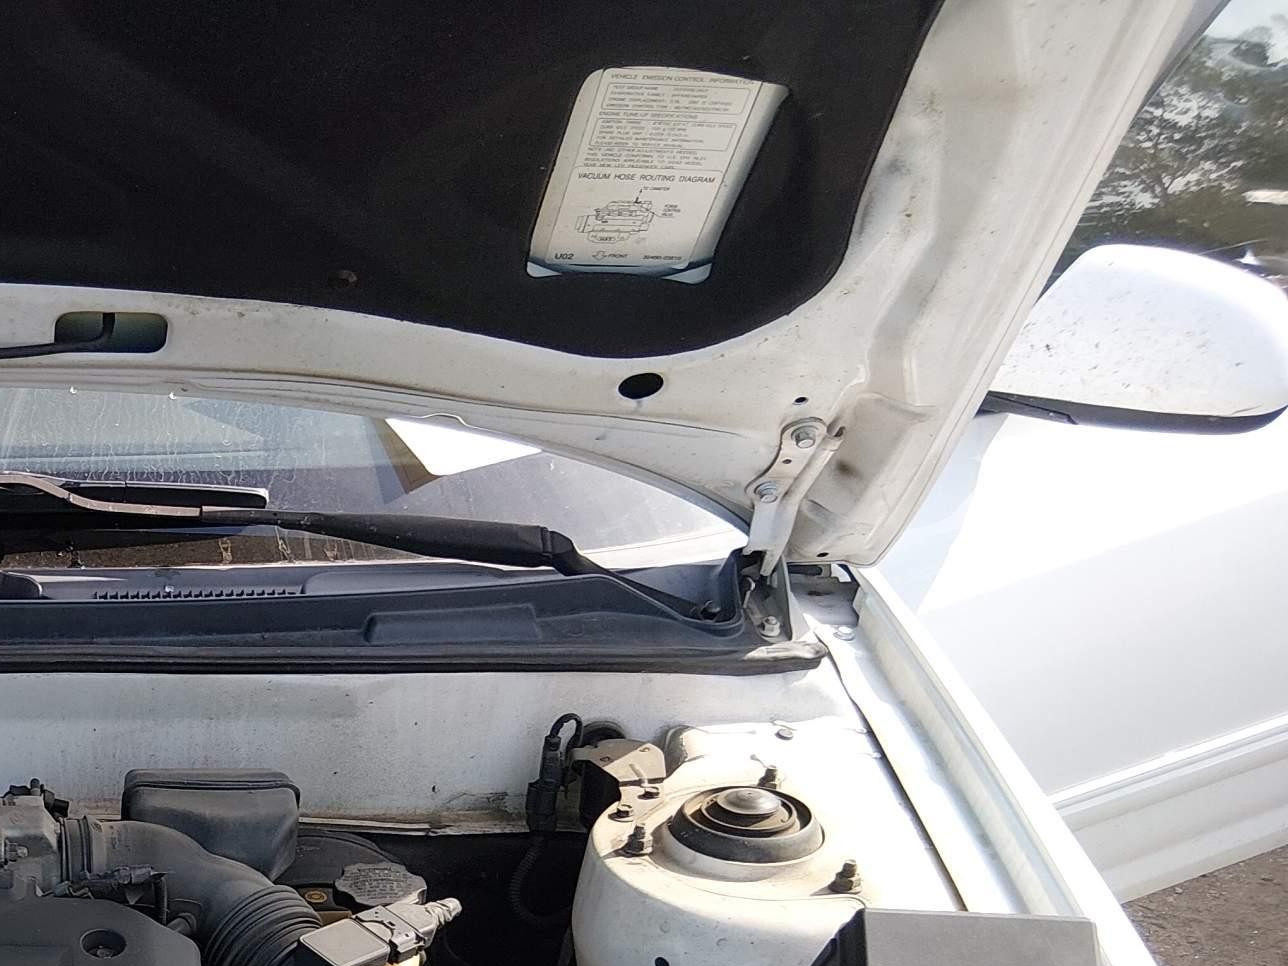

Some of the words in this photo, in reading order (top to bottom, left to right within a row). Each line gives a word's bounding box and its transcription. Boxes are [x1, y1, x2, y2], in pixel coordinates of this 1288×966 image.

[577, 172, 611, 180] VACUUM
[613, 173, 637, 181] HOSE
[639, 174, 676, 182] ROUTING
[678, 175, 717, 184] DIAGRAM
